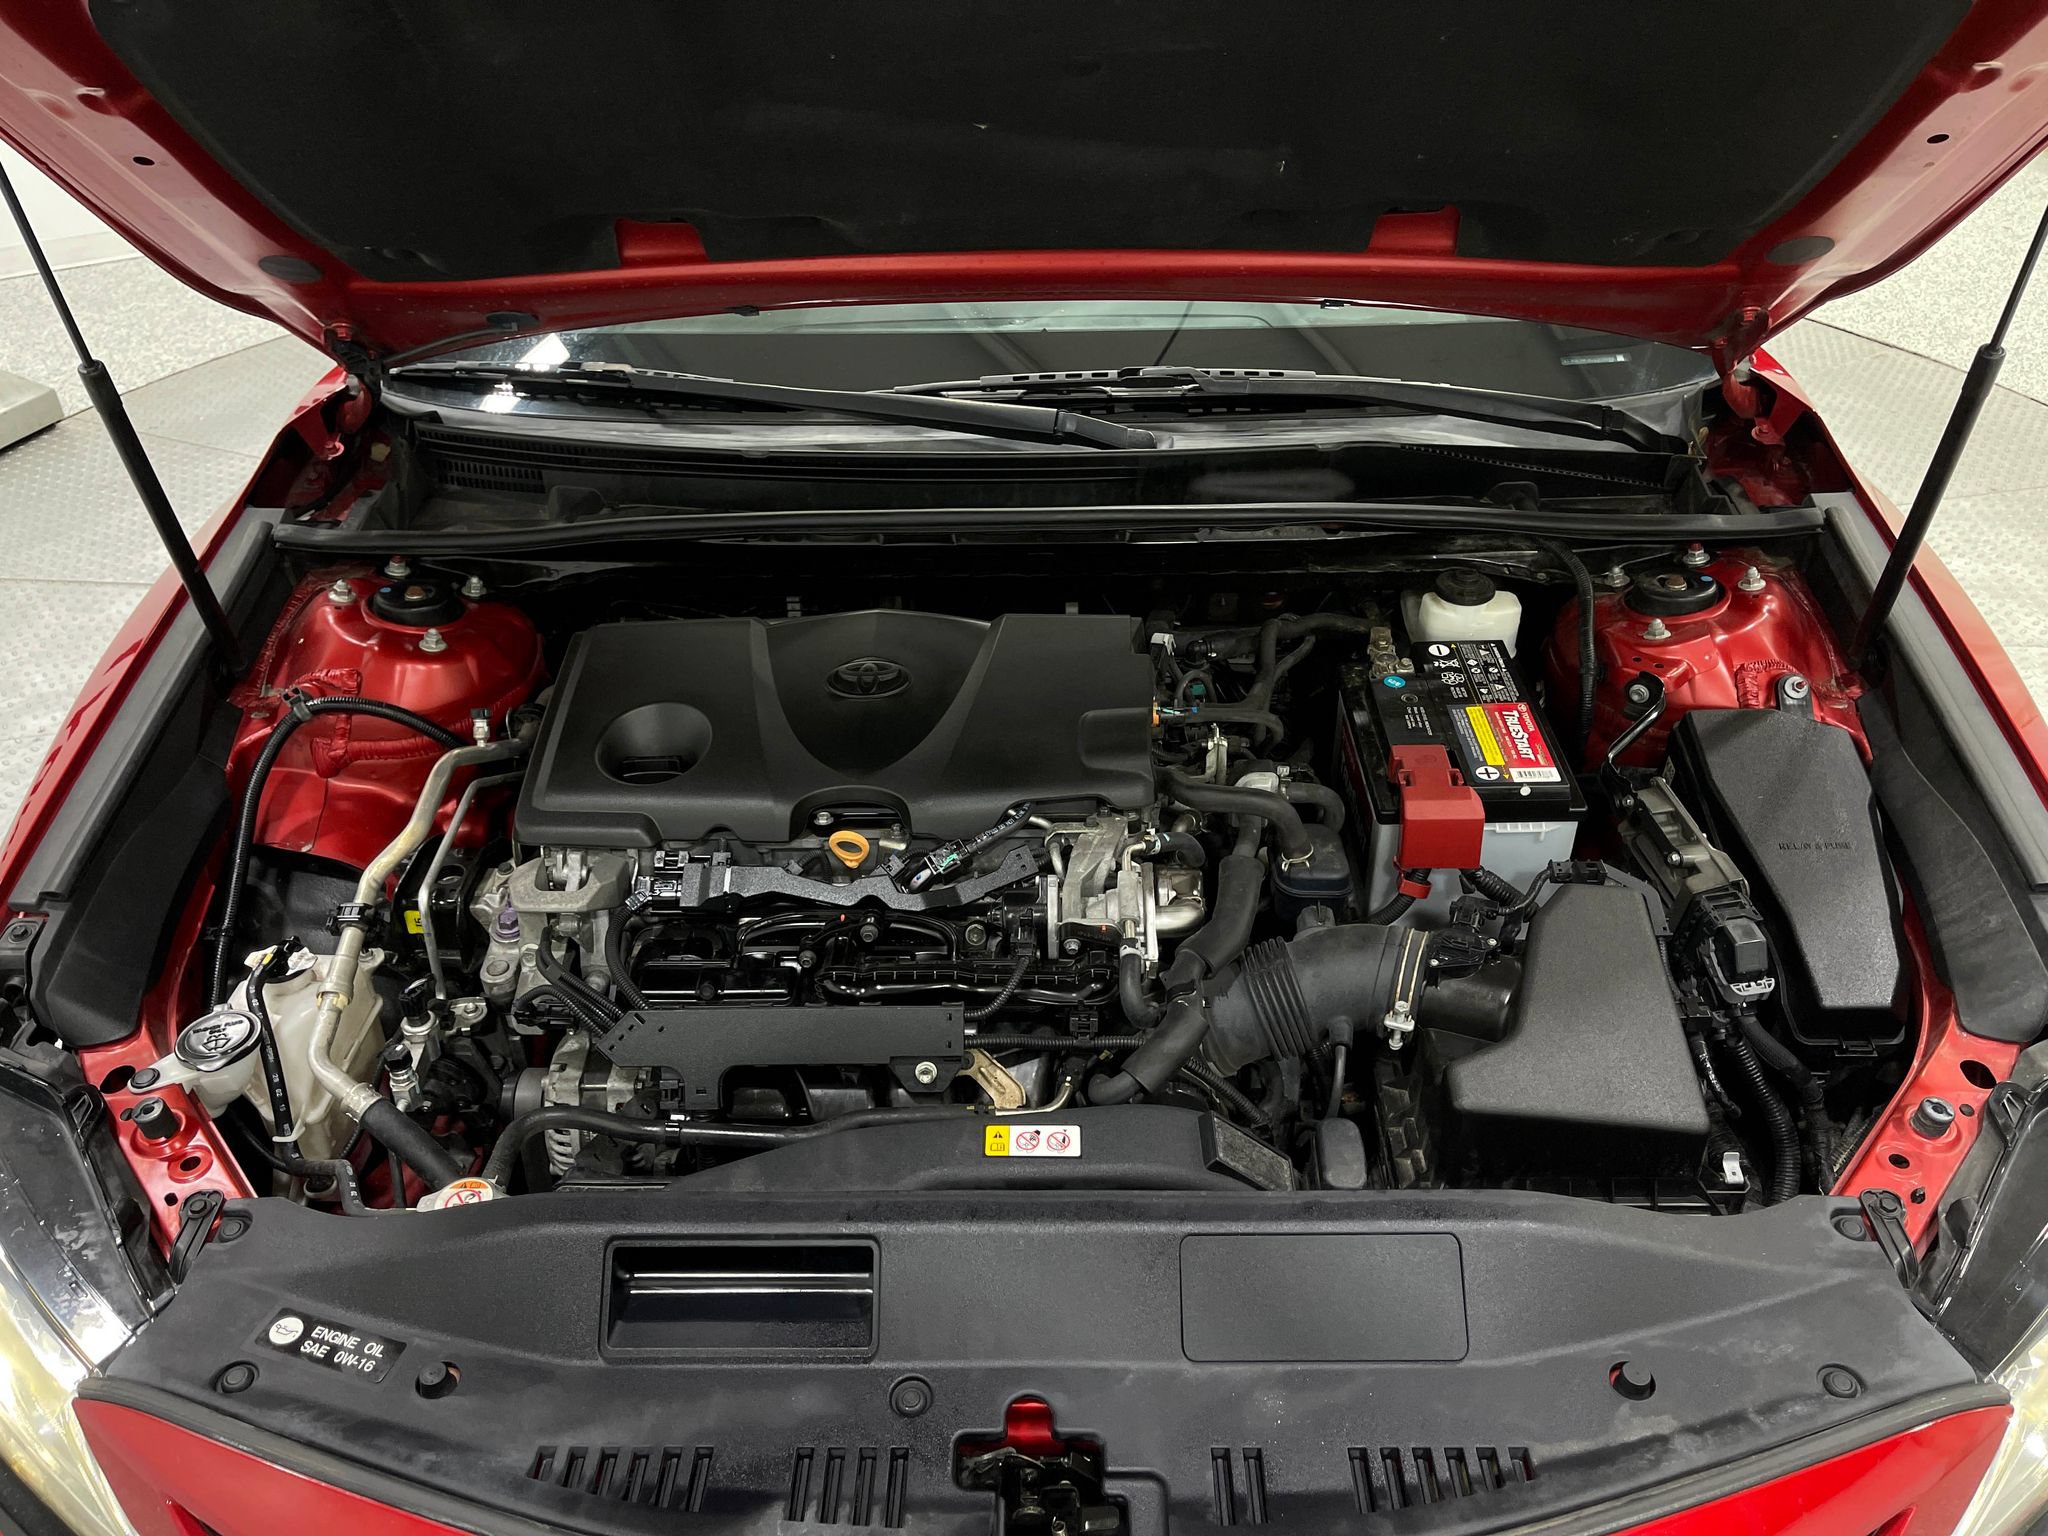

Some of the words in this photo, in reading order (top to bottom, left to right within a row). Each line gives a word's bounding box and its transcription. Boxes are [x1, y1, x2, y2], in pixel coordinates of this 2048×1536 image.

[1521, 711, 1535, 732] TOYOTA
[1778, 842, 1812, 851] RELAY
[224, 1019, 244, 1028] FLUID
[311, 1326, 361, 1349] ENGINE
[363, 1342, 385, 1358] OIL
[300, 1340, 330, 1358] SAE
[333, 1350, 376, 1372] 0W-16
